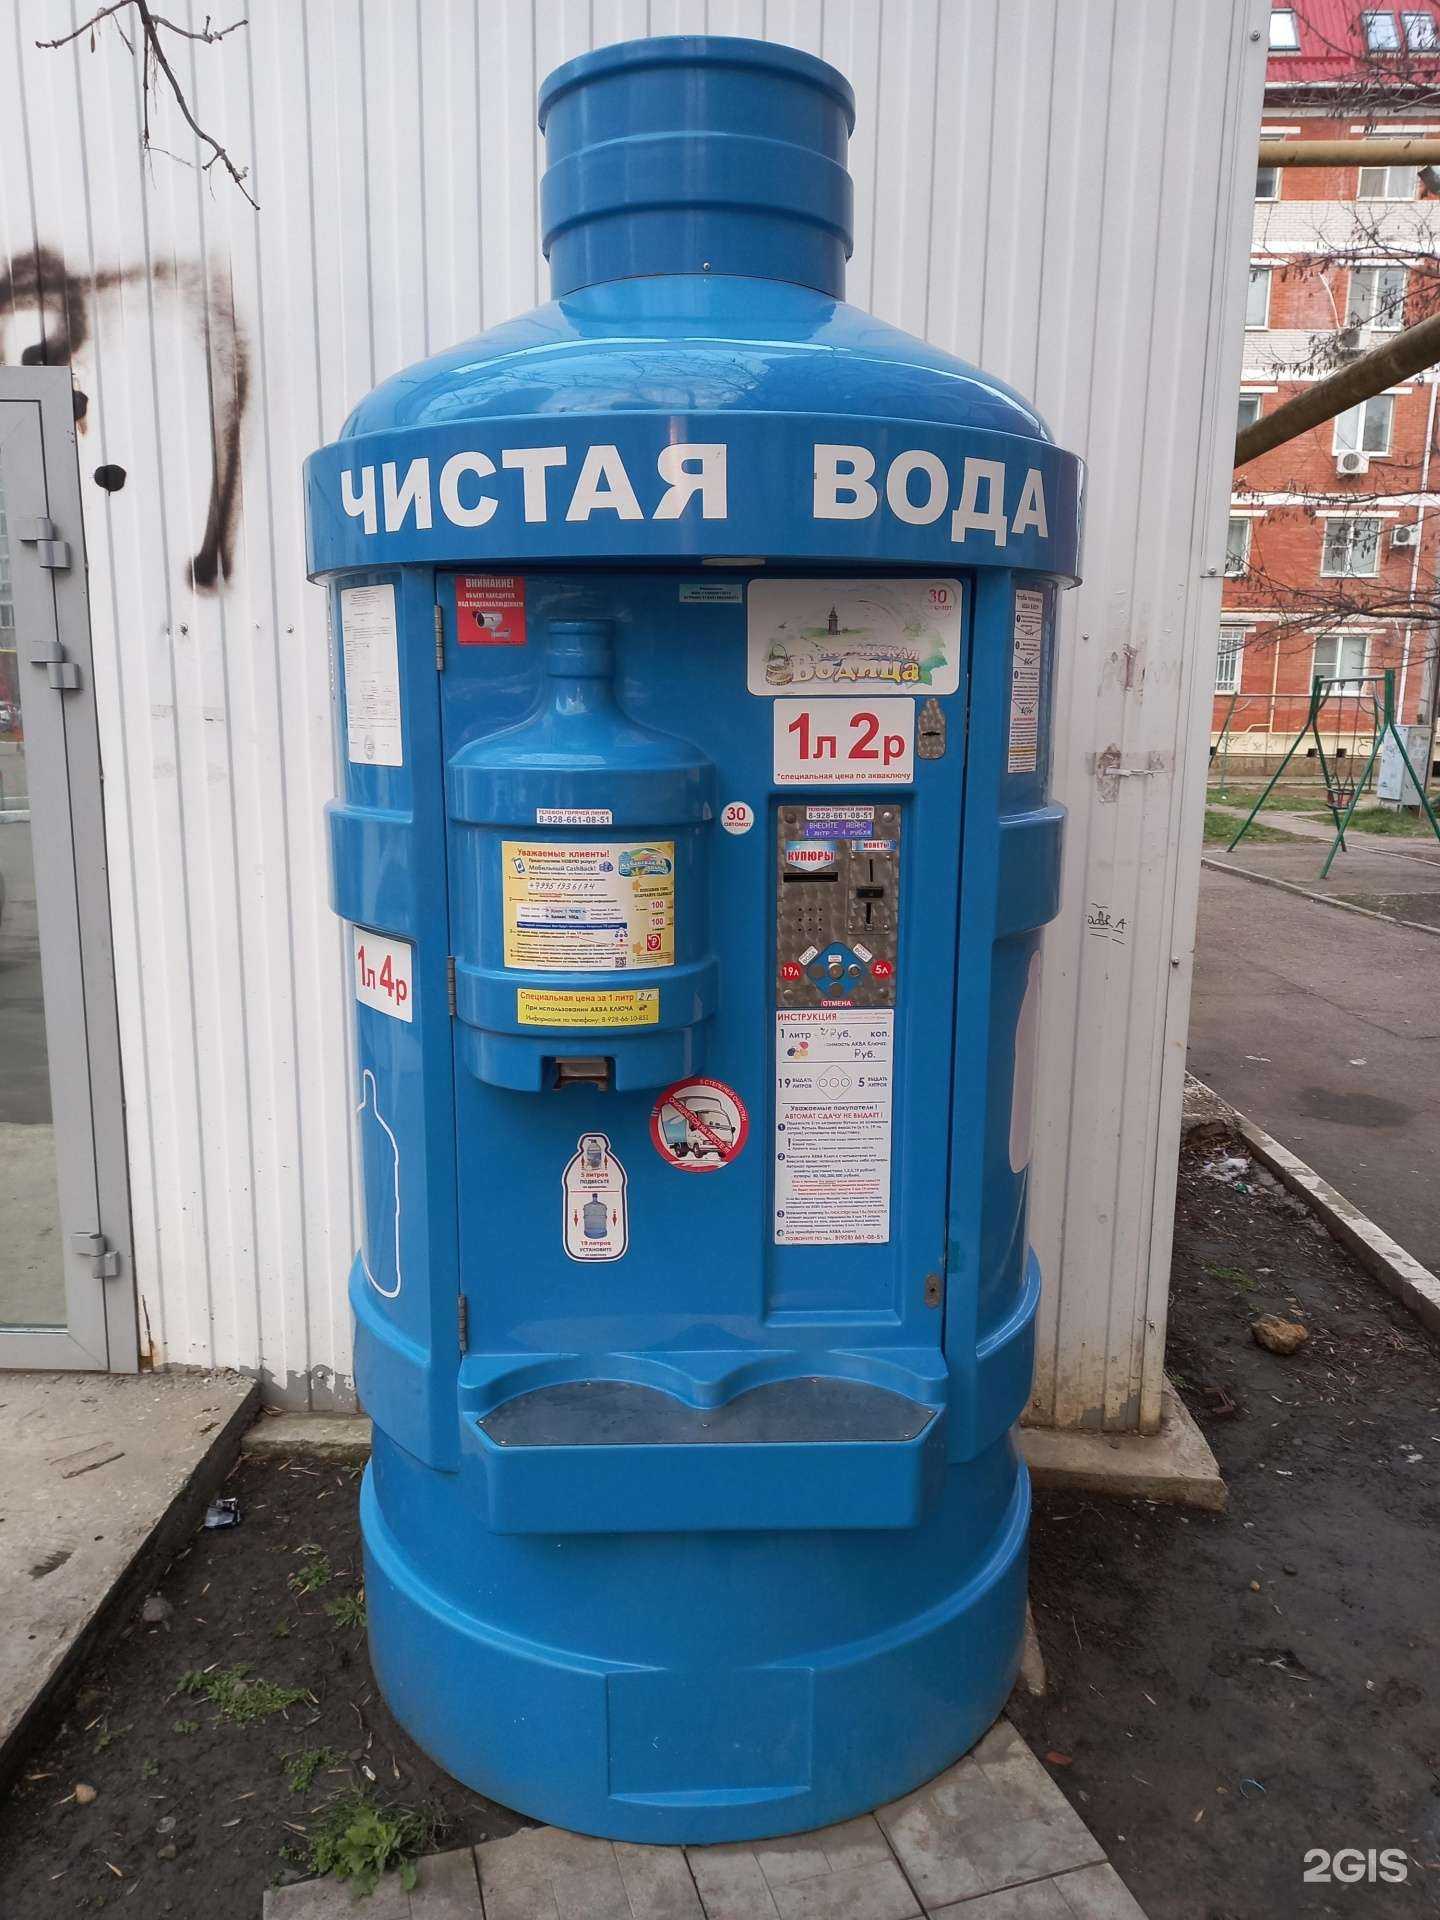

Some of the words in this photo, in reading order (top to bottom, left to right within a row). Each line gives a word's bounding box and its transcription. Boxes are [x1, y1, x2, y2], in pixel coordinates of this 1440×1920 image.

[341, 443, 728, 534] ЧИСТАЯ
[813, 444, 1049, 546] ВОДА
[928, 589, 947, 603] 30
[788, 713, 837, 760] 1л
[848, 712, 906, 766] 2р
[727, 806, 746, 820] 30
[539, 815, 610, 824] 8-928-661-08-51
[517, 848, 566, 857] Уважаемые
[568, 849, 610, 858] клиенты!
[788, 851, 834, 861] КУПЮРЫ
[529, 864, 565, 872] Мобильный
[652, 901, 664, 909] 100
[652, 918, 664, 926] 100
[783, 966, 800, 977] 19л
[875, 965, 889, 974] 5л
[358, 945, 376, 990] 1л
[380, 955, 408, 1006] 4р
[520, 991, 574, 1002] Специальная
[575, 995, 596, 1003] цена
[614, 994, 634, 1003] литр
[777, 1013, 837, 1021] ИНСТРУКЦИЯ
[780, 1028, 785, 1039] 1
[788, 1032, 812, 1040] литр
[870, 1030, 890, 1038] коп.
[854, 1049, 876, 1060] Руб.
[777, 1078, 791, 1089] 19
[858, 1077, 865, 1088] 5
